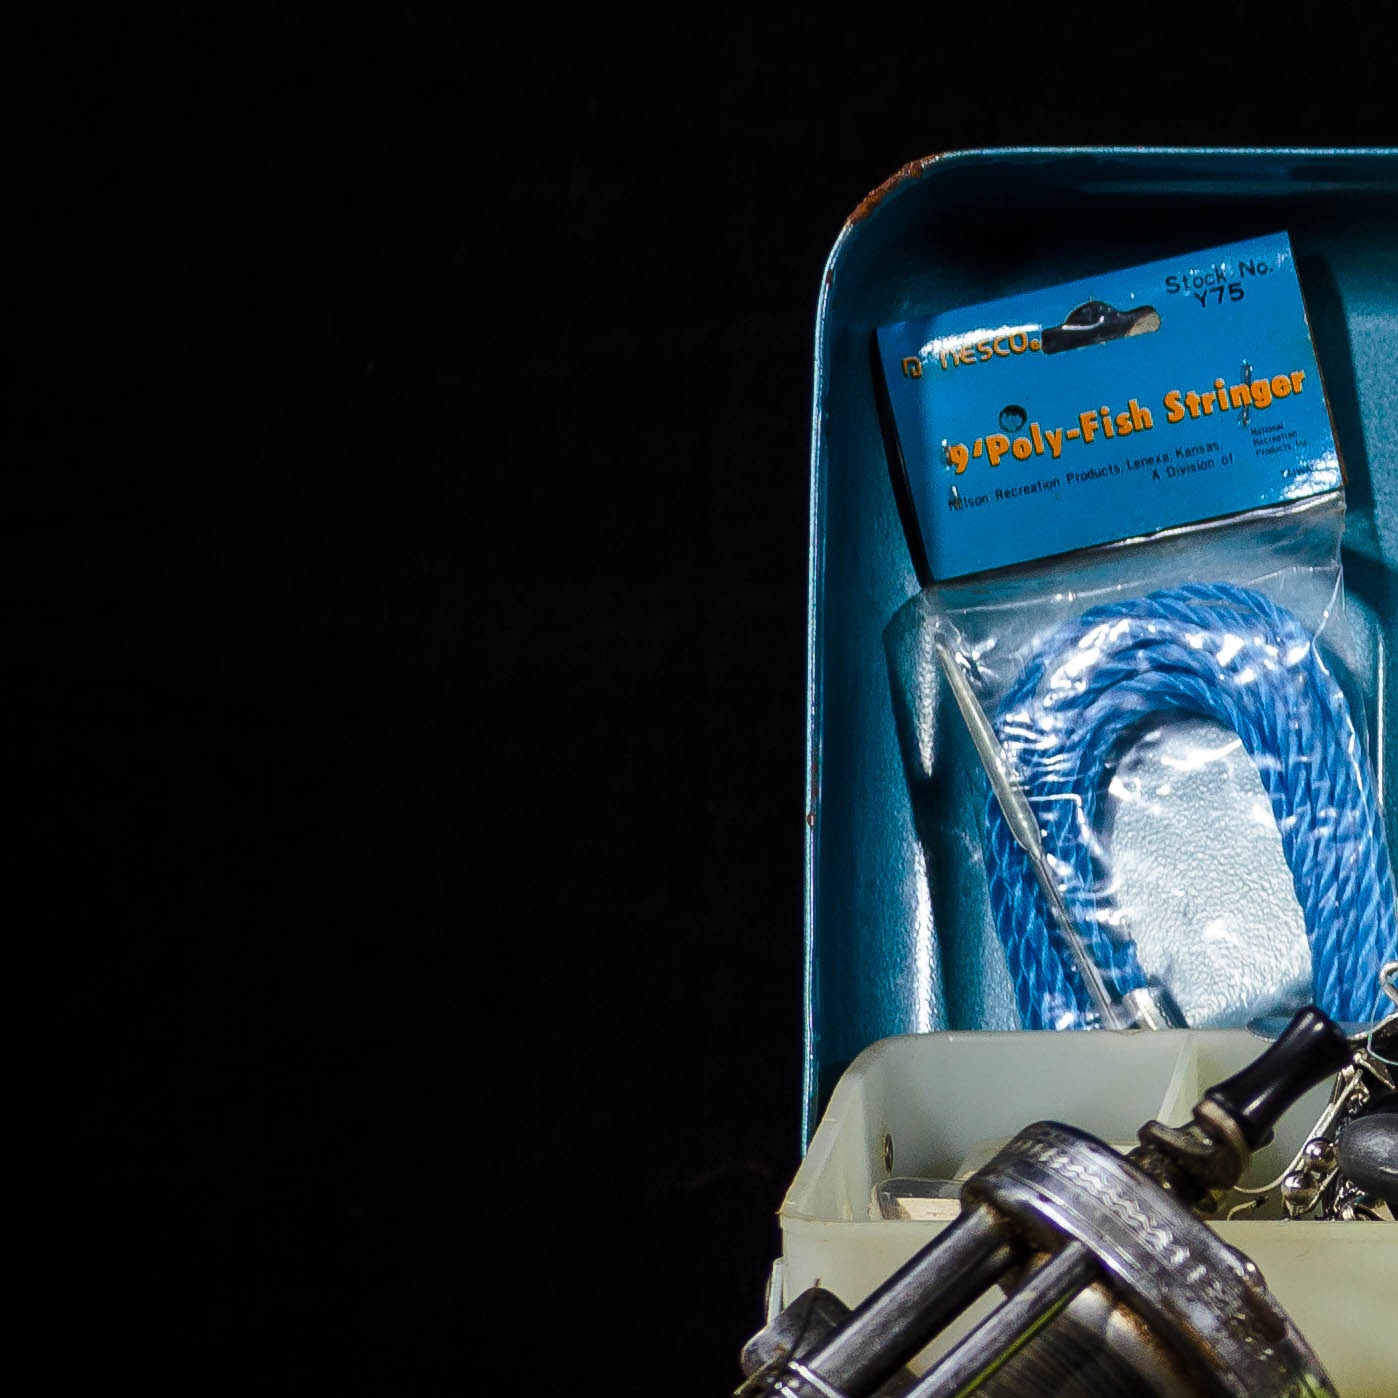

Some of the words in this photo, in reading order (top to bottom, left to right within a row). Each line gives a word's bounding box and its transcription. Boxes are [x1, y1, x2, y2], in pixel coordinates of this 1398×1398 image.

[1165, 265, 1227, 294] Stock
[1238, 258, 1273, 278] No.
[1194, 282, 1245, 308] Y75
[1164, 370, 1305, 424] Stringer
[1151, 470, 1161, 480] A
[1167, 457, 1216, 479] Division
[995, 477, 1061, 501] Recreation
